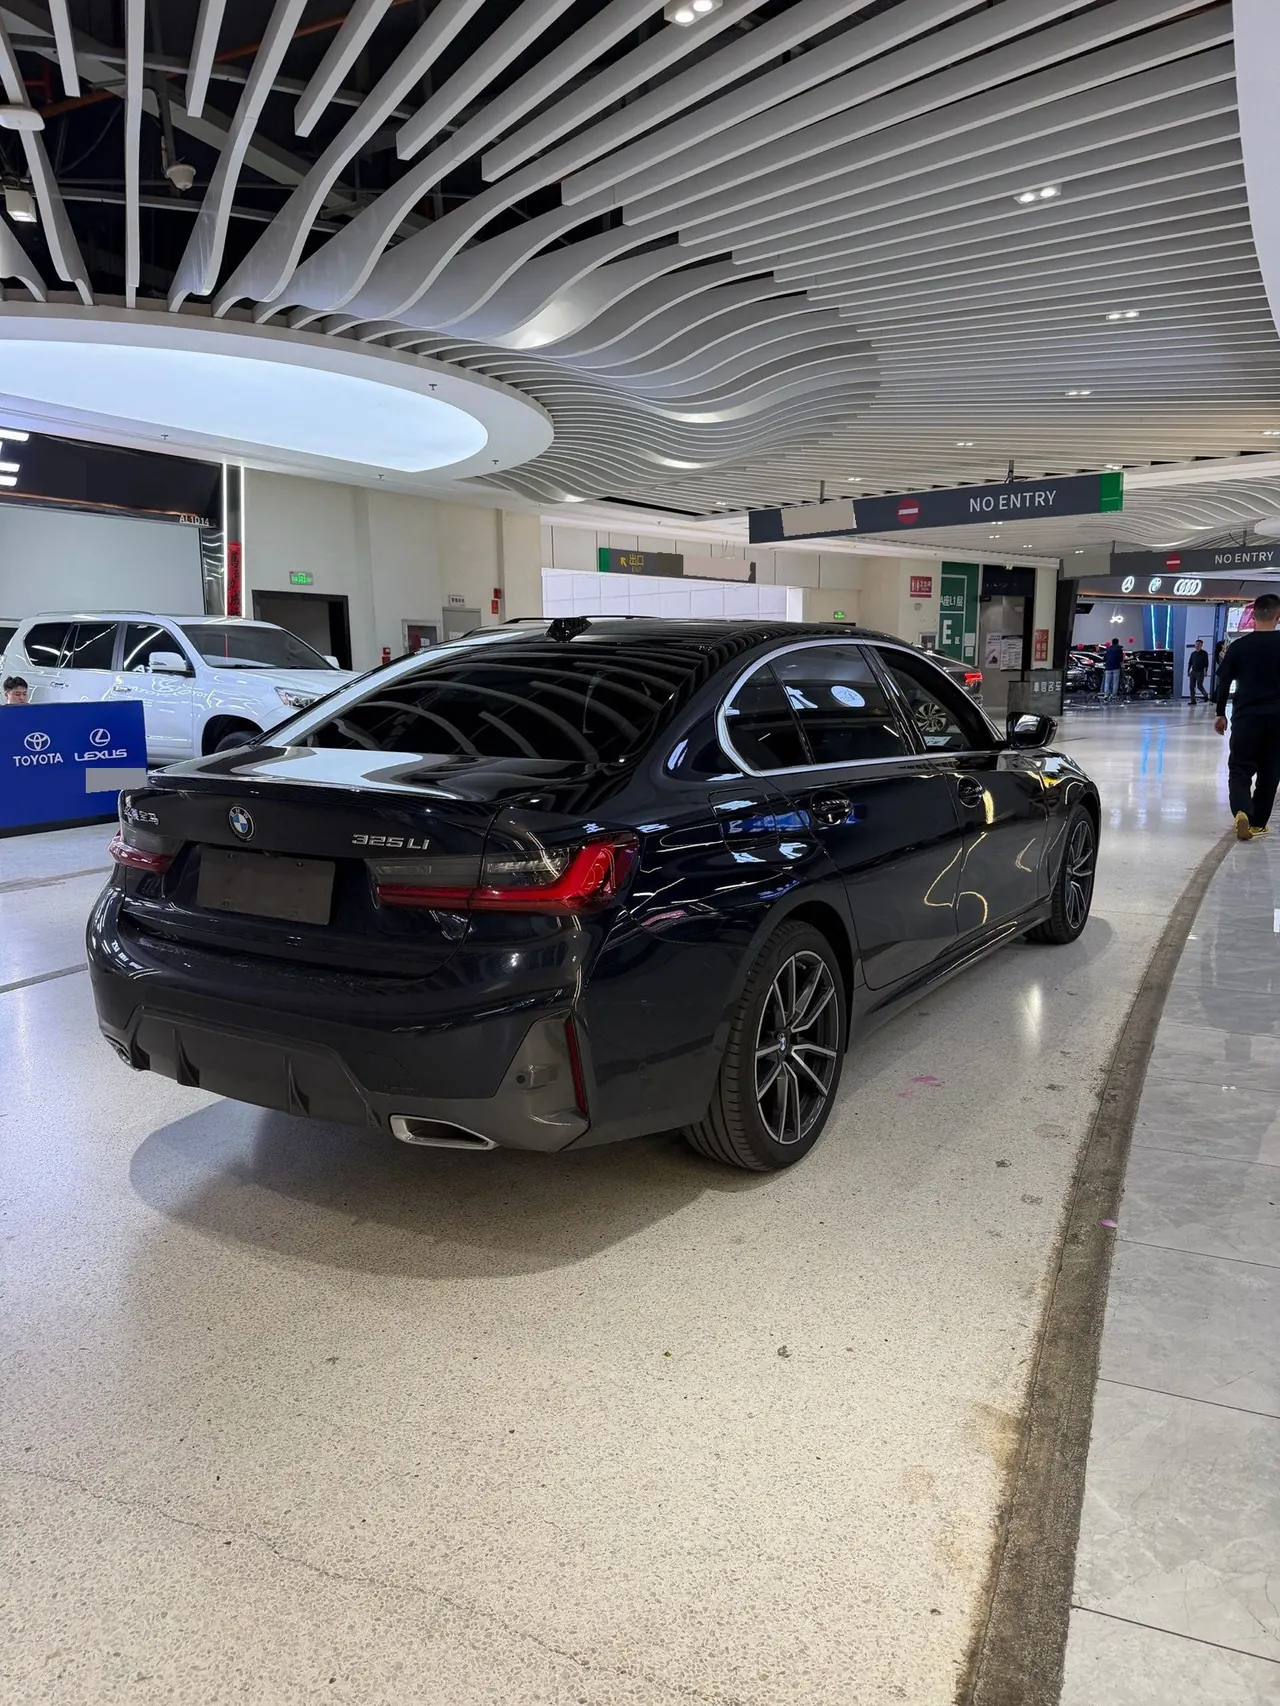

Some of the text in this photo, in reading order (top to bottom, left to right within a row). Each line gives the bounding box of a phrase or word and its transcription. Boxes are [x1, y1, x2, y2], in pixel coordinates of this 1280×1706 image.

[969, 490, 1057, 513] NO ENTRY
[179, 515, 210, 527] AL1D14
[629, 553, 644, 565] 出口
[1214, 551, 1275, 564] NO ENTRY
[13, 752, 64, 767] TOYOTA
[74, 748, 128, 762] LEXUS
